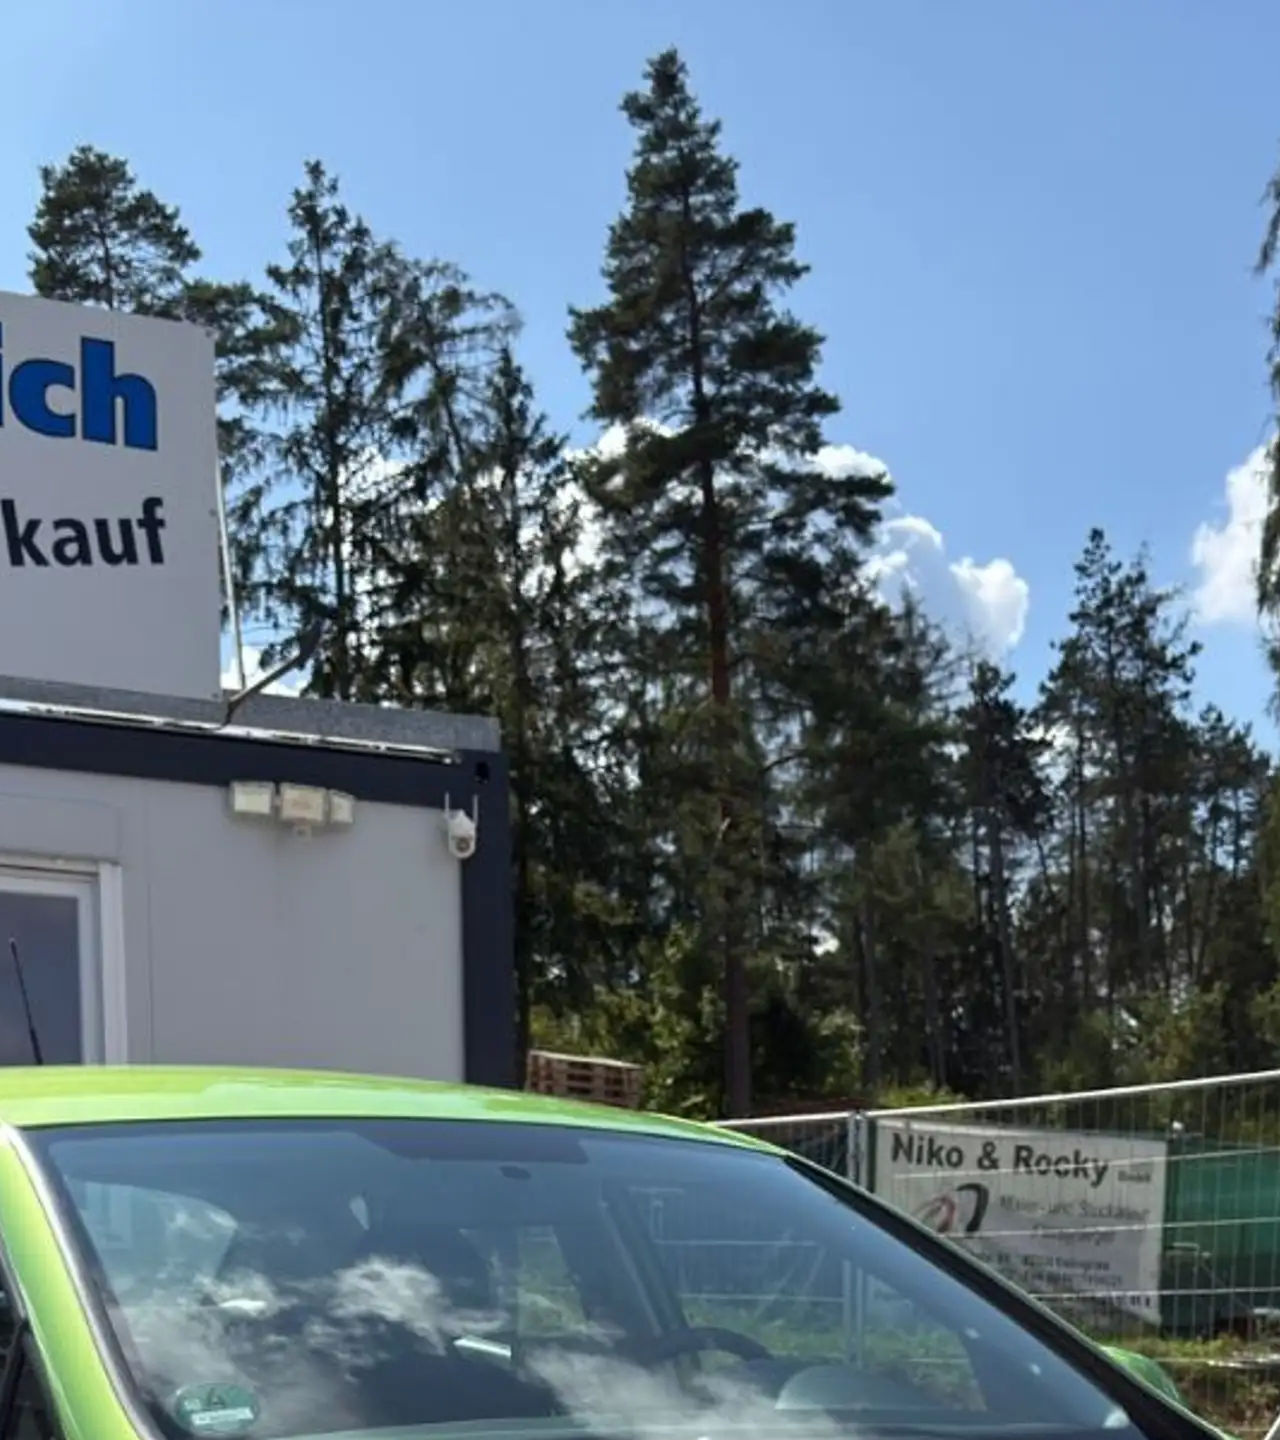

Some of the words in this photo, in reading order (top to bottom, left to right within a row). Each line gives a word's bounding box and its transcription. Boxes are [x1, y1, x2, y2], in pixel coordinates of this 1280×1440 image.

[891, 1132, 964, 1169] Niko
[977, 1141, 999, 1171] &
[1014, 1145, 1109, 1188] Rocky
